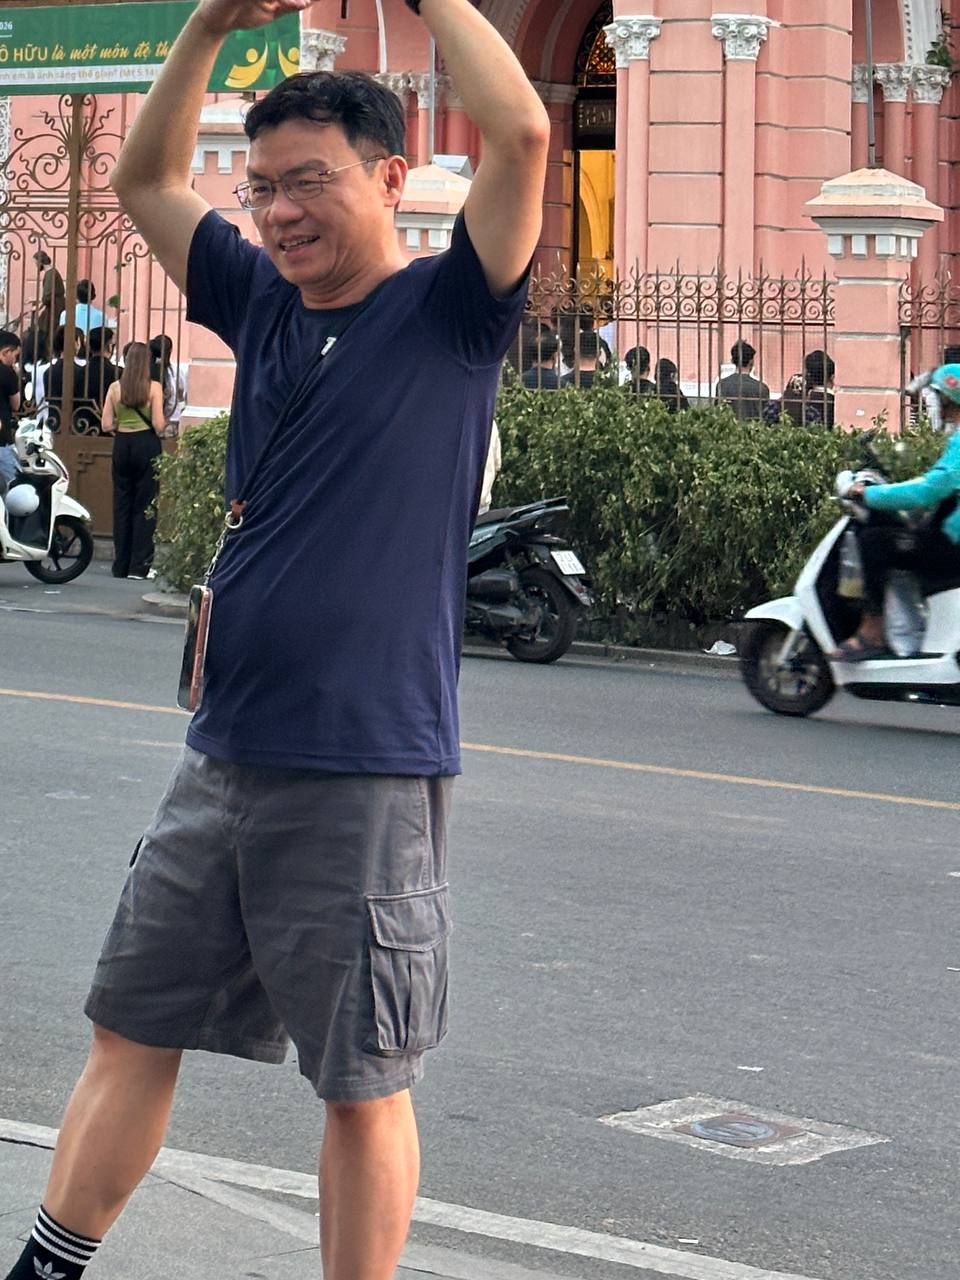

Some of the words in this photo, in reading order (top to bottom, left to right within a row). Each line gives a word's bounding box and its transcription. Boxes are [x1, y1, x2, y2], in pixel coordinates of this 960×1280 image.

[14, 43, 48, 62] HỮU
[51, 43, 66, 61] là
[70, 43, 98, 63] một
[99, 43, 130, 59] môn
